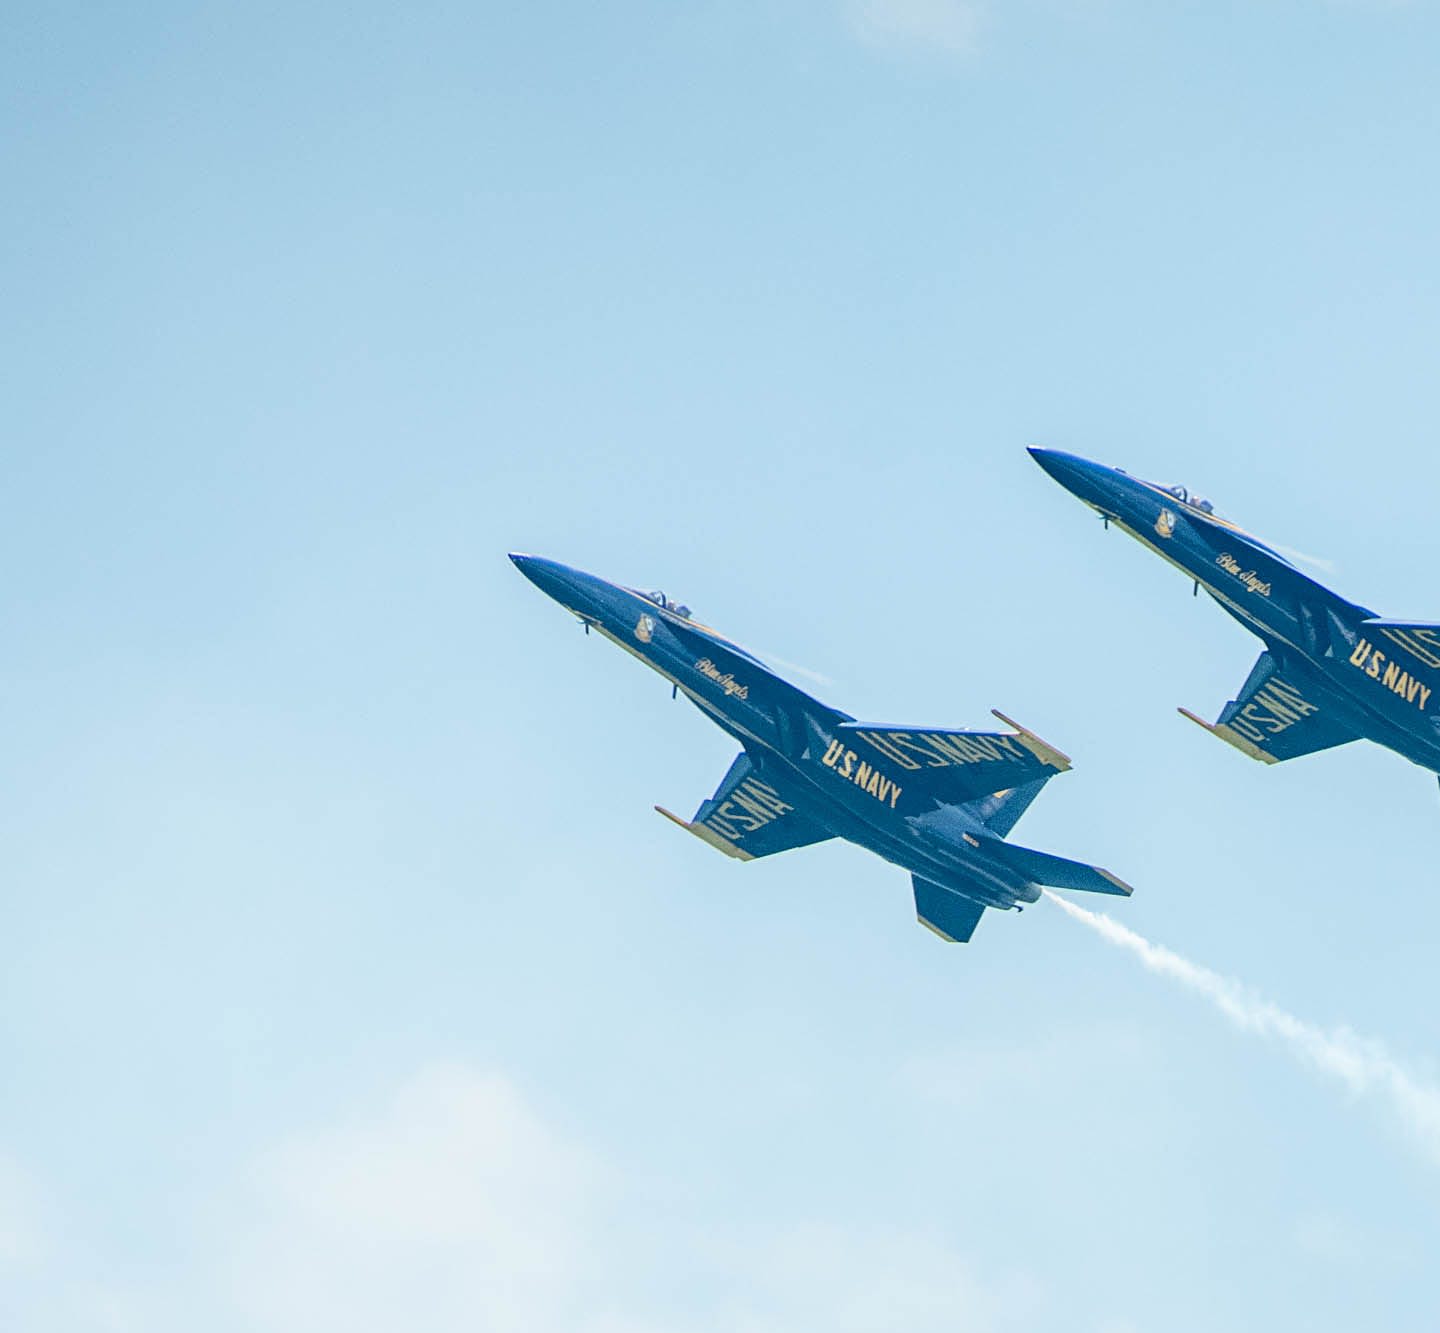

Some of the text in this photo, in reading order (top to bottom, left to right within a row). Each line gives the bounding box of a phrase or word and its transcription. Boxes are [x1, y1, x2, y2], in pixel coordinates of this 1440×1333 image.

[1215, 552, 1271, 597] Blue Angels
[694, 657, 749, 699] Blue Angels
